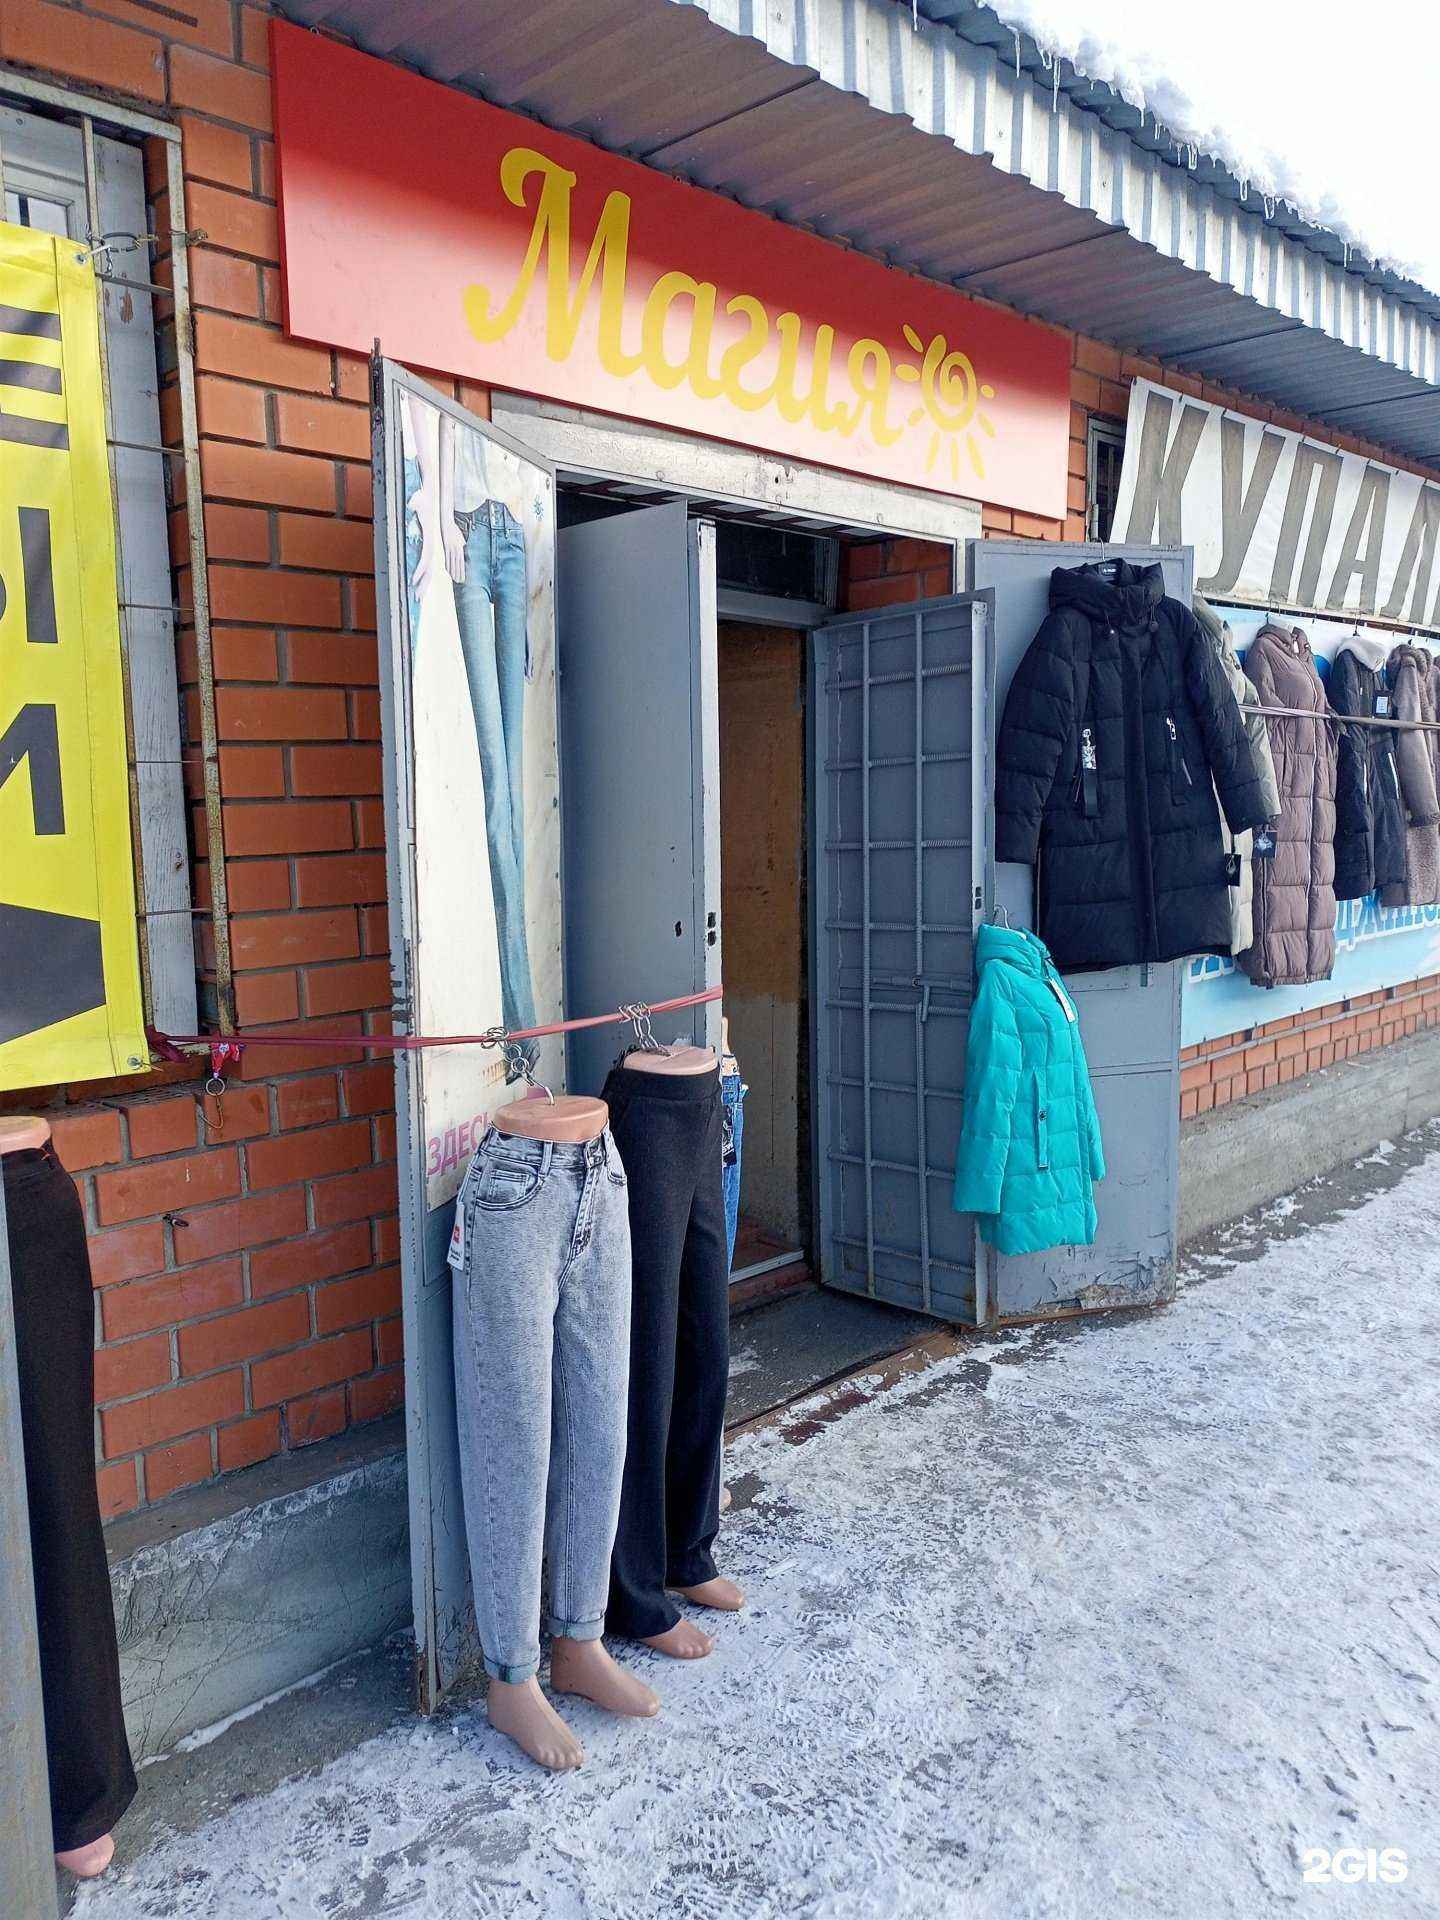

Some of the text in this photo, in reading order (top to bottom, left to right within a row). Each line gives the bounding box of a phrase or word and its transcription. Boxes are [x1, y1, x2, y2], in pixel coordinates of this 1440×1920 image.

[463, 147, 905, 448] Магия
[1125, 389, 1440, 627] КУПАЛ
[427, 1111, 488, 1177] ЗДЕС
